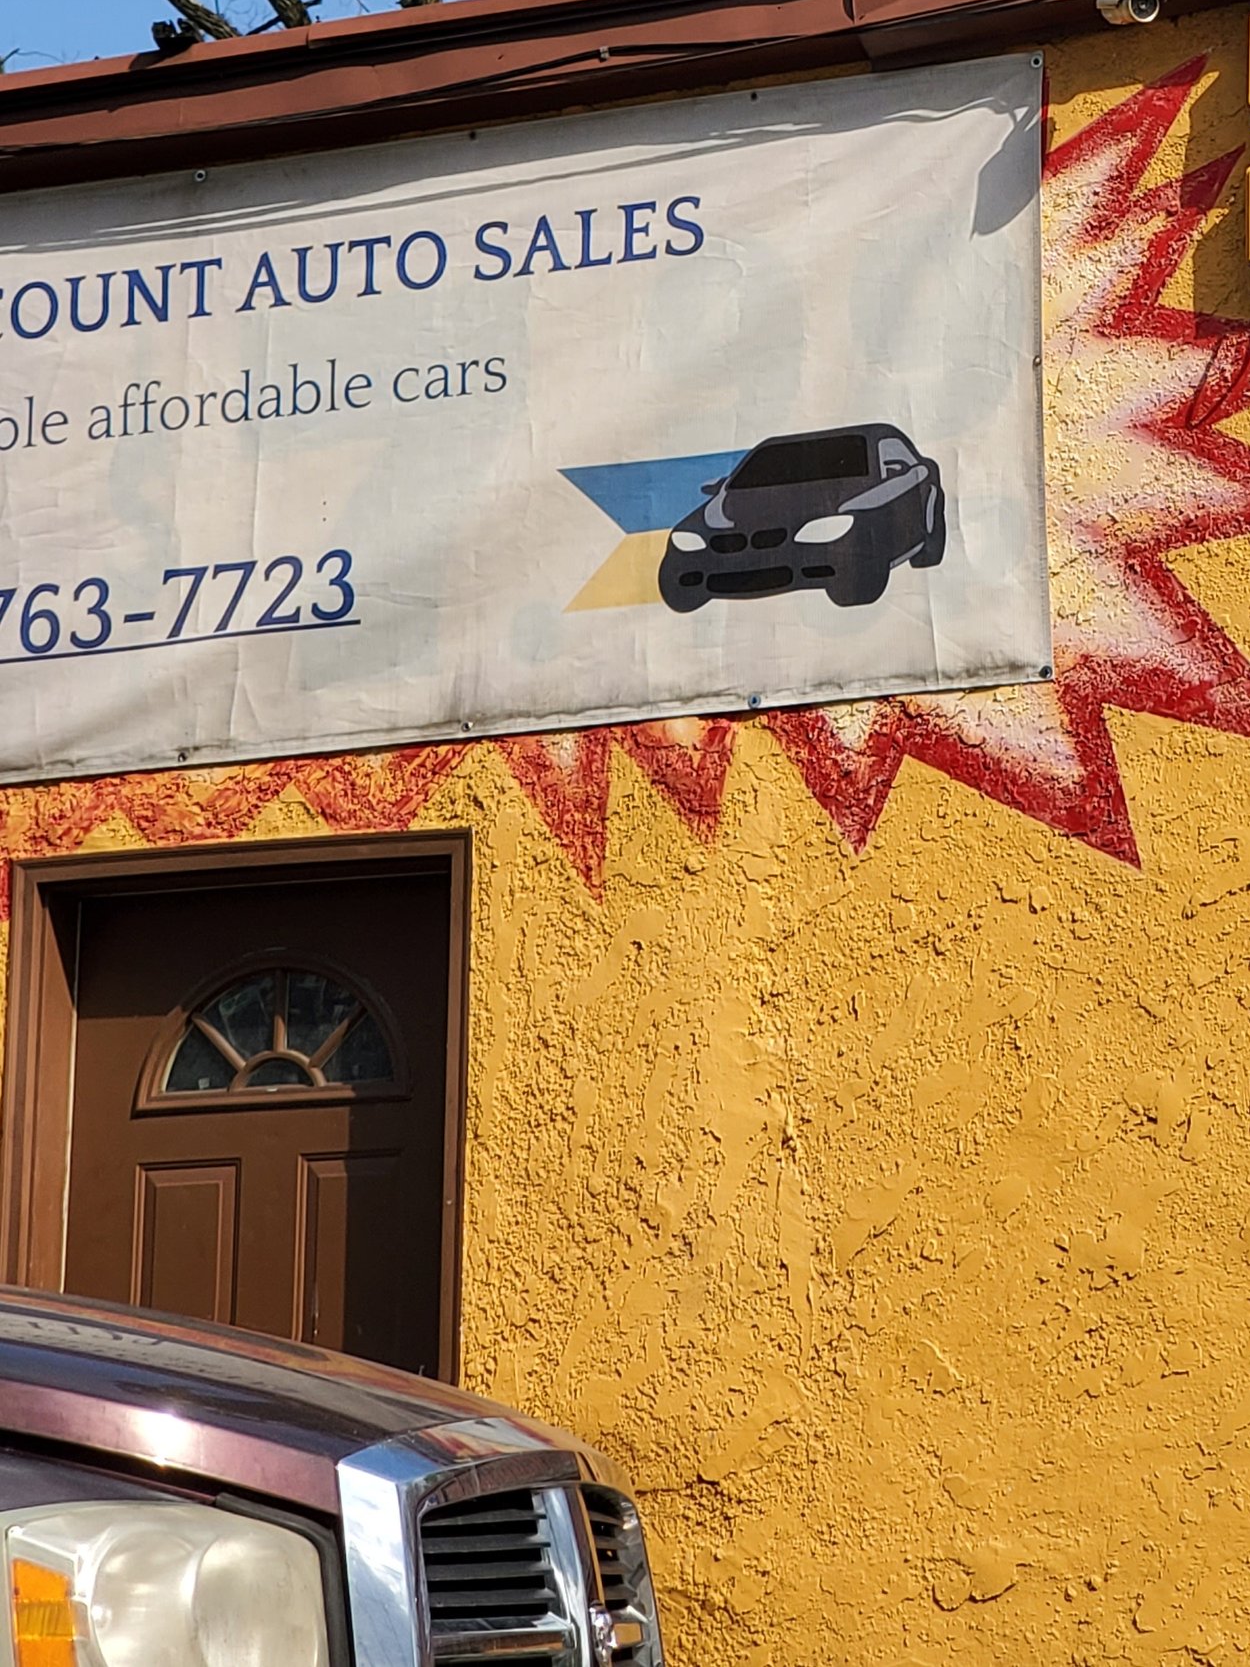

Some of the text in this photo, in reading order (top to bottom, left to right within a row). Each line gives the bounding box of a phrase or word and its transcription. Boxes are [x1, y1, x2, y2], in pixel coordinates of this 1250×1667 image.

[0, 194, 706, 340] OUNT AUTO SALES
[86, 358, 374, 441] affordable
[391, 354, 509, 404] cars
